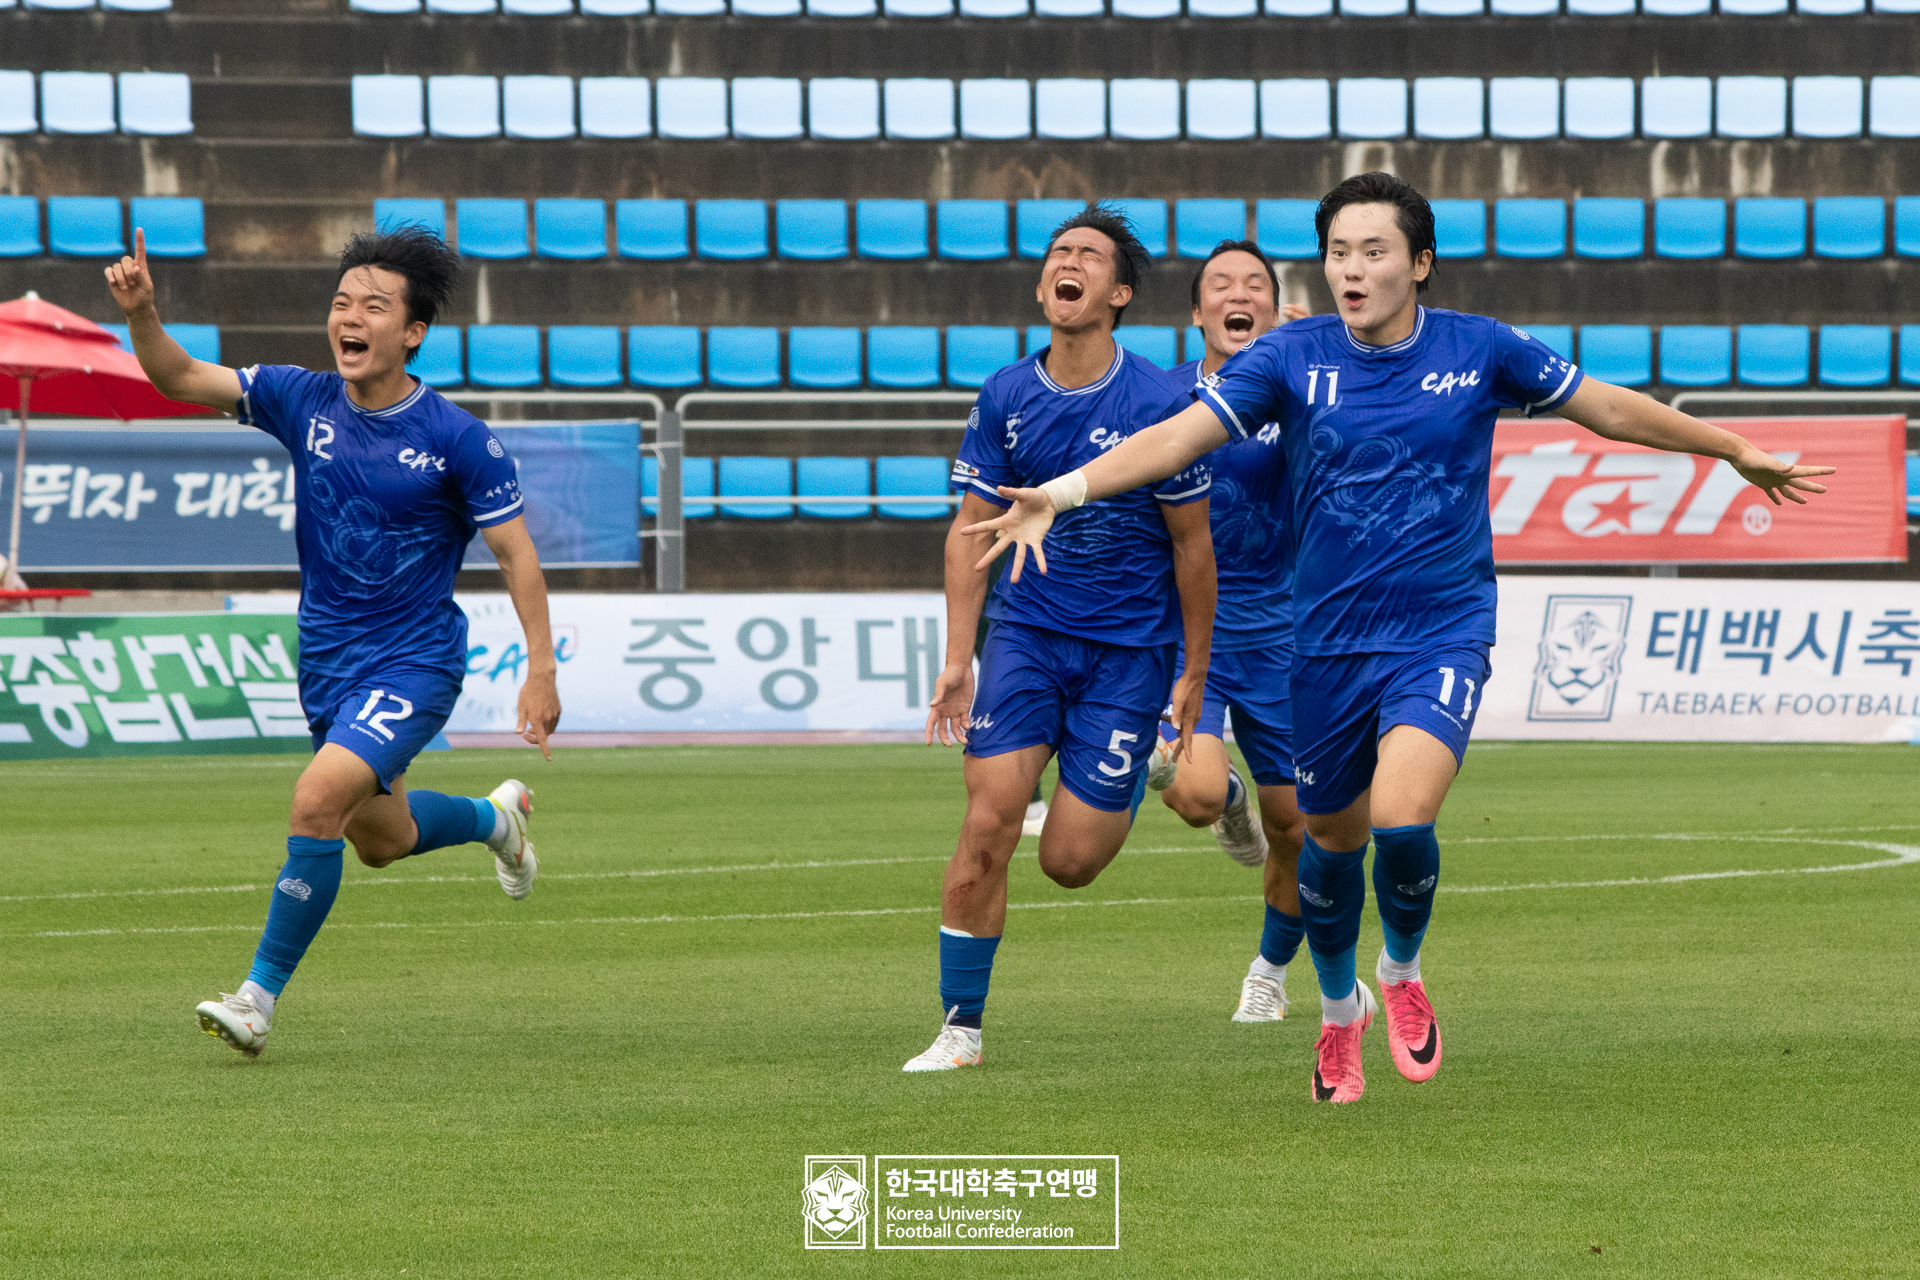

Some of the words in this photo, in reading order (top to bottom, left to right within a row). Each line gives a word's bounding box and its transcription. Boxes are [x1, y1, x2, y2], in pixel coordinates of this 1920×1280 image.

[1307, 370, 1339, 406] 11
[1421, 369, 1481, 396] CAU
[306, 418, 335, 460] 12
[1004, 418, 1022, 450] 5
[1089, 427, 1129, 450] CA
[22, 463, 157, 524] 뛰자
[0, 631, 309, 748] 종합건설
[1438, 667, 1476, 721] 11
[1638, 691, 1766, 715] TAEBAEK
[355, 689, 413, 741] 12
[1097, 729, 1139, 778] 5
